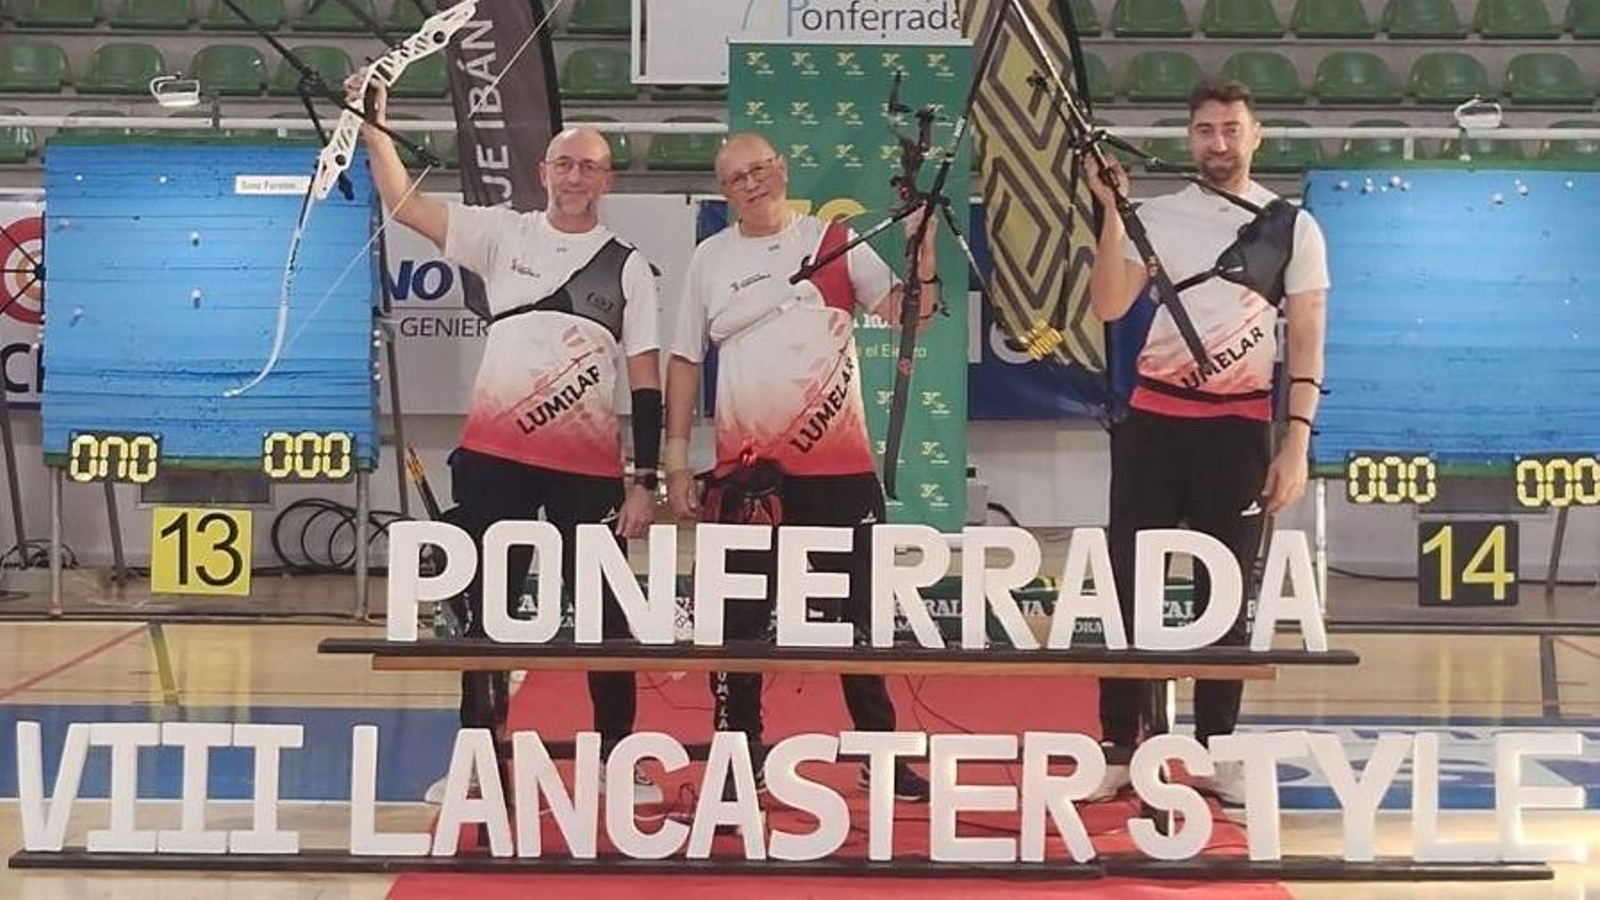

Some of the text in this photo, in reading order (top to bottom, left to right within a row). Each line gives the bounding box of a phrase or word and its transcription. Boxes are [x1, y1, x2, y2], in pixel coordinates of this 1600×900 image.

[457, 19, 503, 129] IBÁN
[264, 432, 350, 479] 000
[1349, 456, 1437, 503] 000
[161, 512, 243, 587] 13
[388, 520, 1327, 654] PONFERRADA
[1422, 525, 1515, 601] 14
[16, 721, 1588, 864] VIII LANCASTER STYLE
